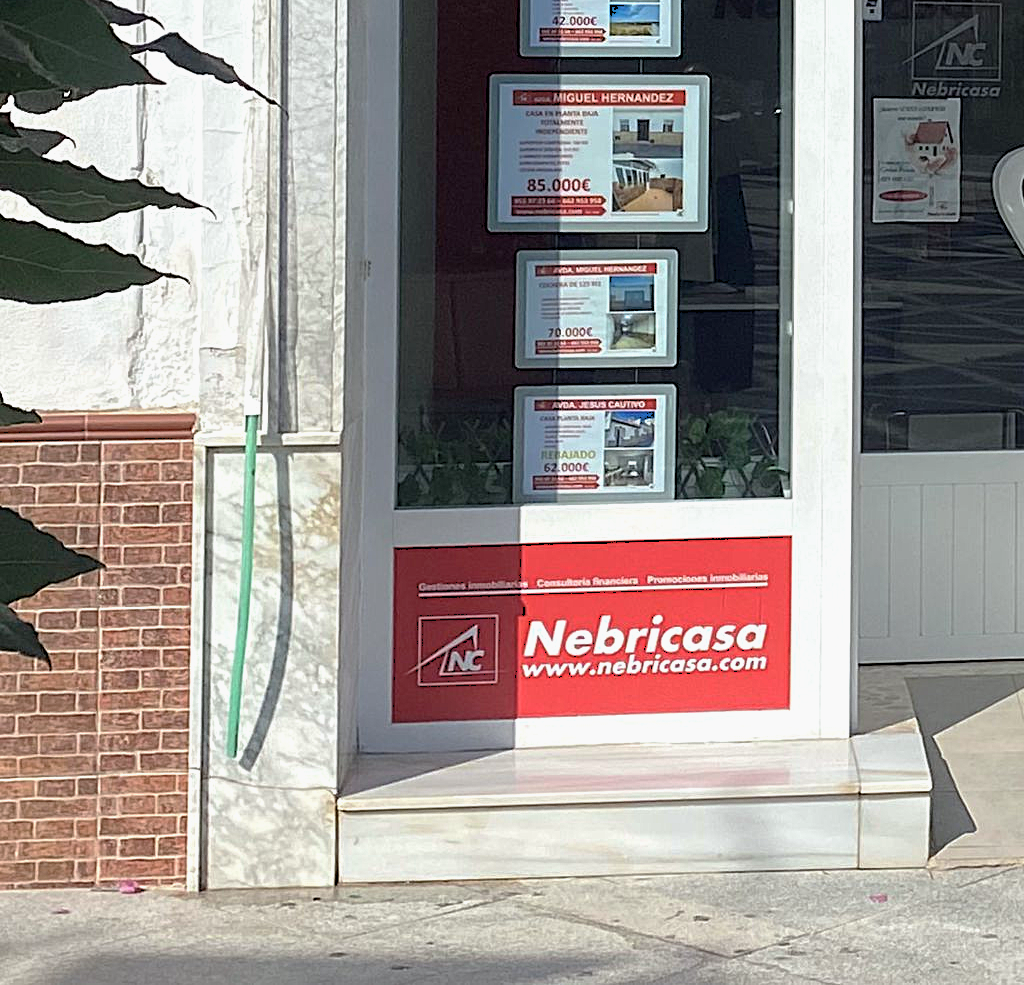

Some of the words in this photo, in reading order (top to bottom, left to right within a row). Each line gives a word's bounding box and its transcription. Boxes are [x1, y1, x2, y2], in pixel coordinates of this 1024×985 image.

[552, 16, 597, 26] 42.000€
[911, 81, 1001, 98] Nebricasa
[553, 93, 598, 103] MIGUEL
[601, 92, 674, 103] HERNANDEZ
[527, 178, 591, 191] 85.000€
[548, 327, 593, 337] 70.000€
[608, 400, 645, 409] CAUTIVO
[544, 462, 590, 472] 62.000€
[647, 575, 707, 584] Promociones
[523, 615, 768, 658] Nebricasa
[521, 653, 767, 677] www.nebricasa.com
